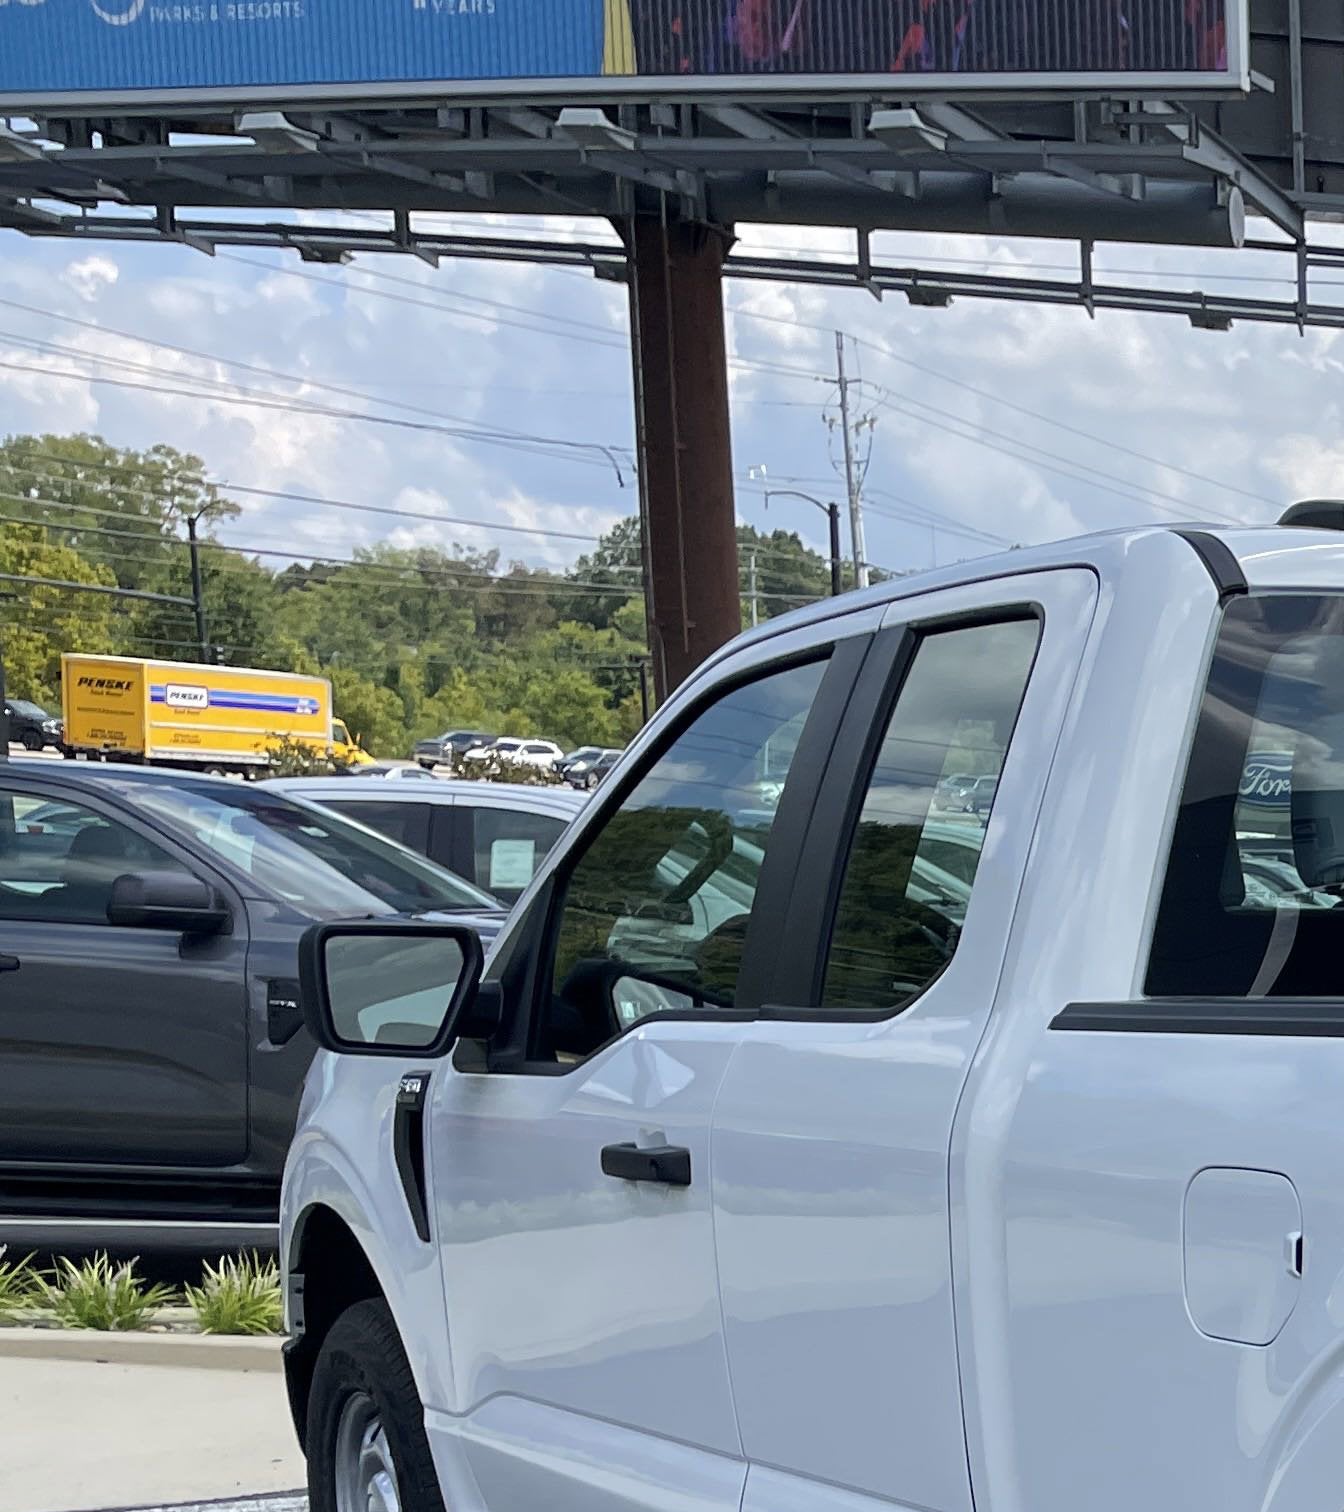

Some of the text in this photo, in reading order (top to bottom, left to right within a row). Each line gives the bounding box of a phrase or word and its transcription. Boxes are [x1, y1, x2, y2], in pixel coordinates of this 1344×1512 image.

[227, 1, 305, 20] RESORTS
[77, 677, 134, 690] PENSKE
[1238, 762, 1292, 797] For
